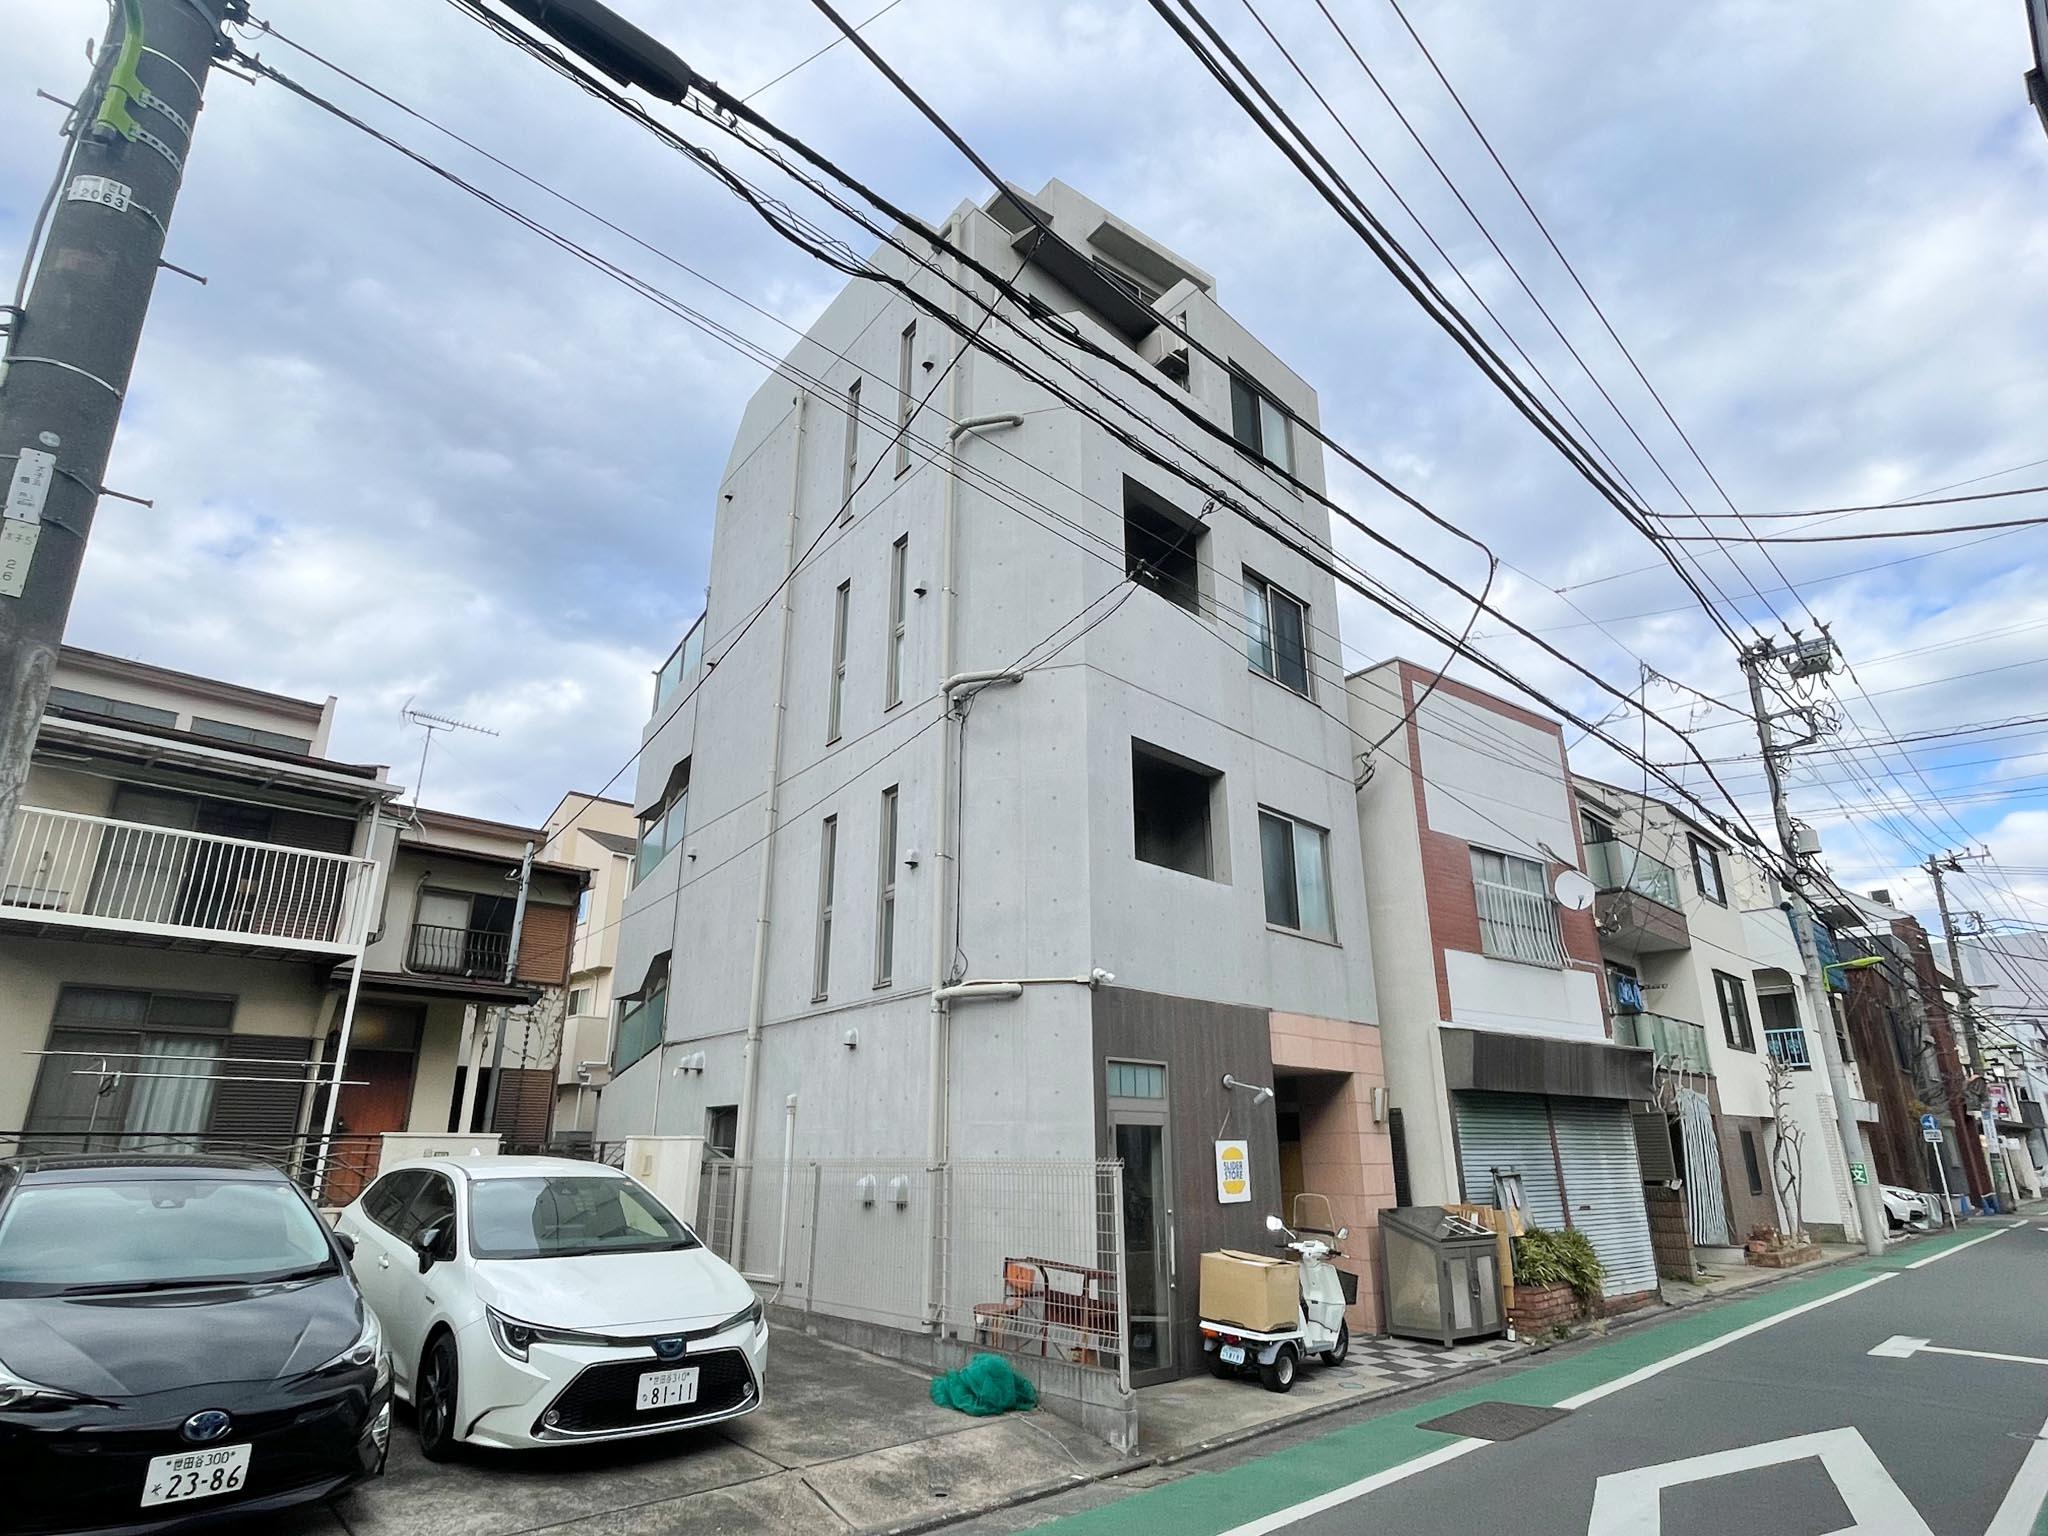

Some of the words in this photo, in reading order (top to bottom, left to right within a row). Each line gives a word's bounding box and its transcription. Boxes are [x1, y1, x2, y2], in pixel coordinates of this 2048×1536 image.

[1223, 1161, 1243, 1171] SLIDER
[1225, 1171, 1243, 1180] STORE
[651, 1382, 693, 1405] 81-11
[165, 1465, 242, 1499] 23-86
